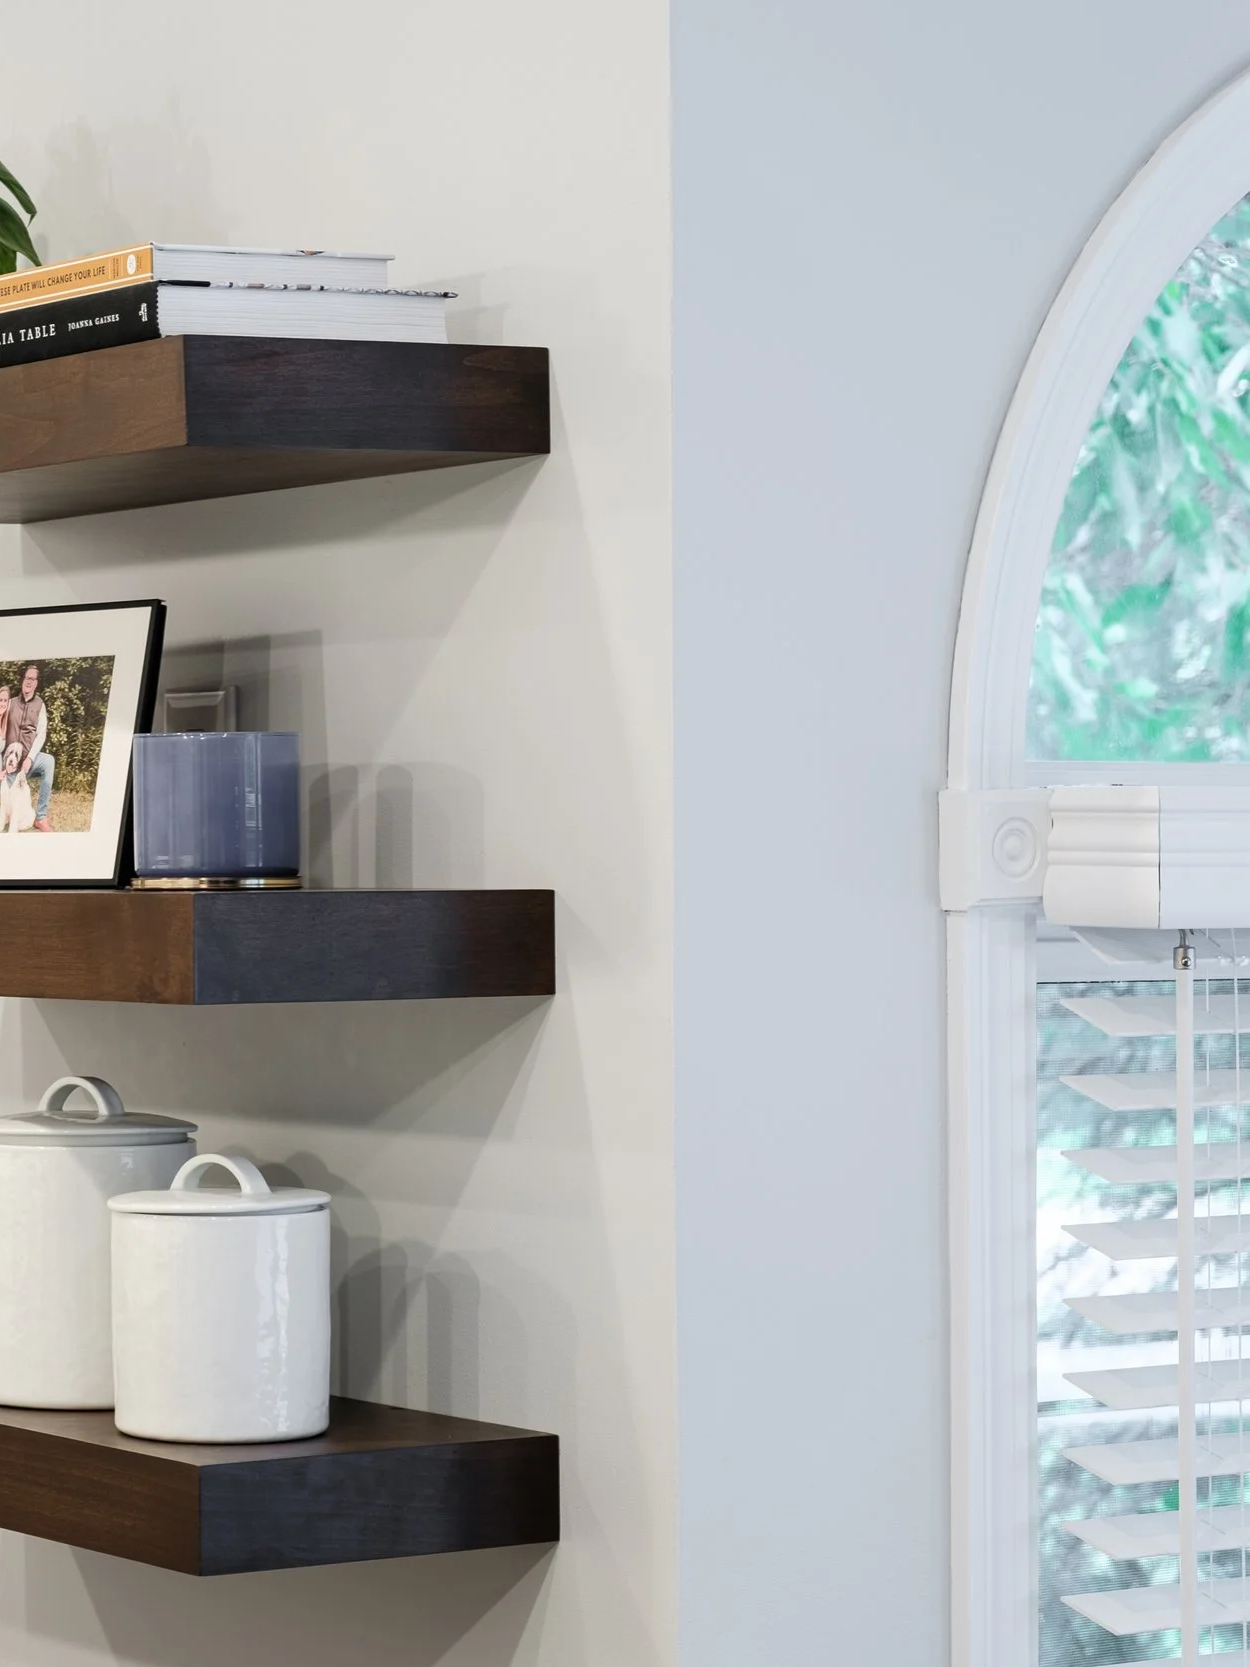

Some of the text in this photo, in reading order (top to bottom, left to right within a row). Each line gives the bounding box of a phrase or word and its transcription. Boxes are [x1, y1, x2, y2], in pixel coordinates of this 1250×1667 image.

[12, 282, 30, 294] PLATE
[30, 278, 46, 290] WILL
[47, 272, 72, 287] CHANGE
[72, 268, 91, 280] YOUR
[93, 265, 106, 277] LIFE
[67, 313, 120, 332] JOANNA GAINES
[19, 323, 57, 342] TABLE
